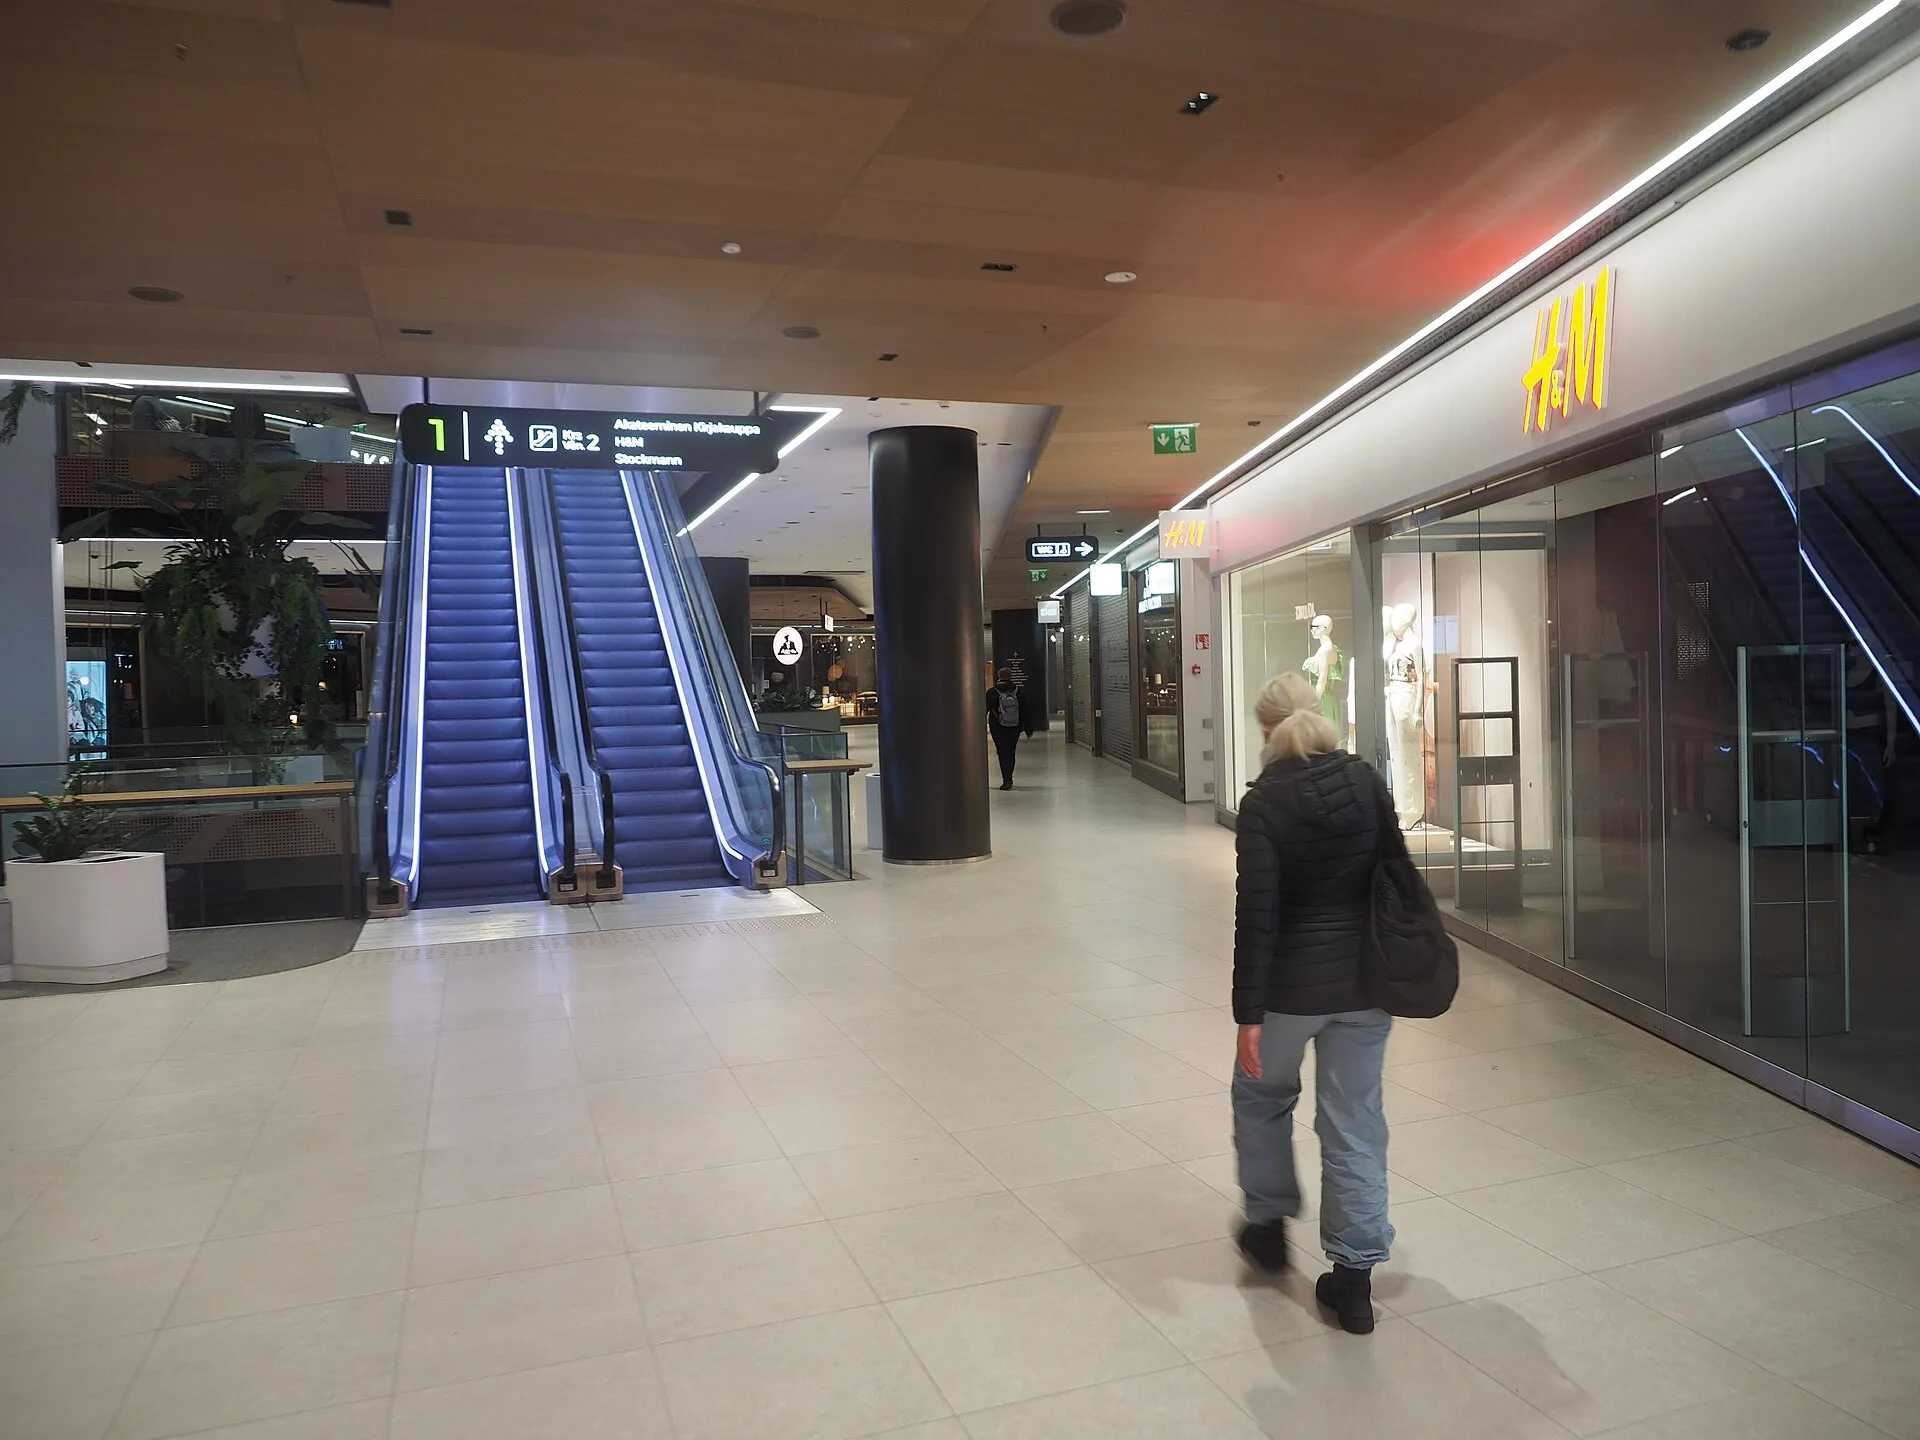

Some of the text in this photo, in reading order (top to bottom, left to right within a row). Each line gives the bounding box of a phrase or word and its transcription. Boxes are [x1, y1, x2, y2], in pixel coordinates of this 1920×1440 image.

[1521, 264, 1610, 434] H&M
[428, 418, 445, 451] 1
[613, 418, 761, 436] Akateeminen Kirjakauppa
[585, 433, 601, 451] 2
[614, 436, 644, 447] H&M
[614, 452, 683, 465] Stockmann
[1164, 520, 1205, 548] H&M
